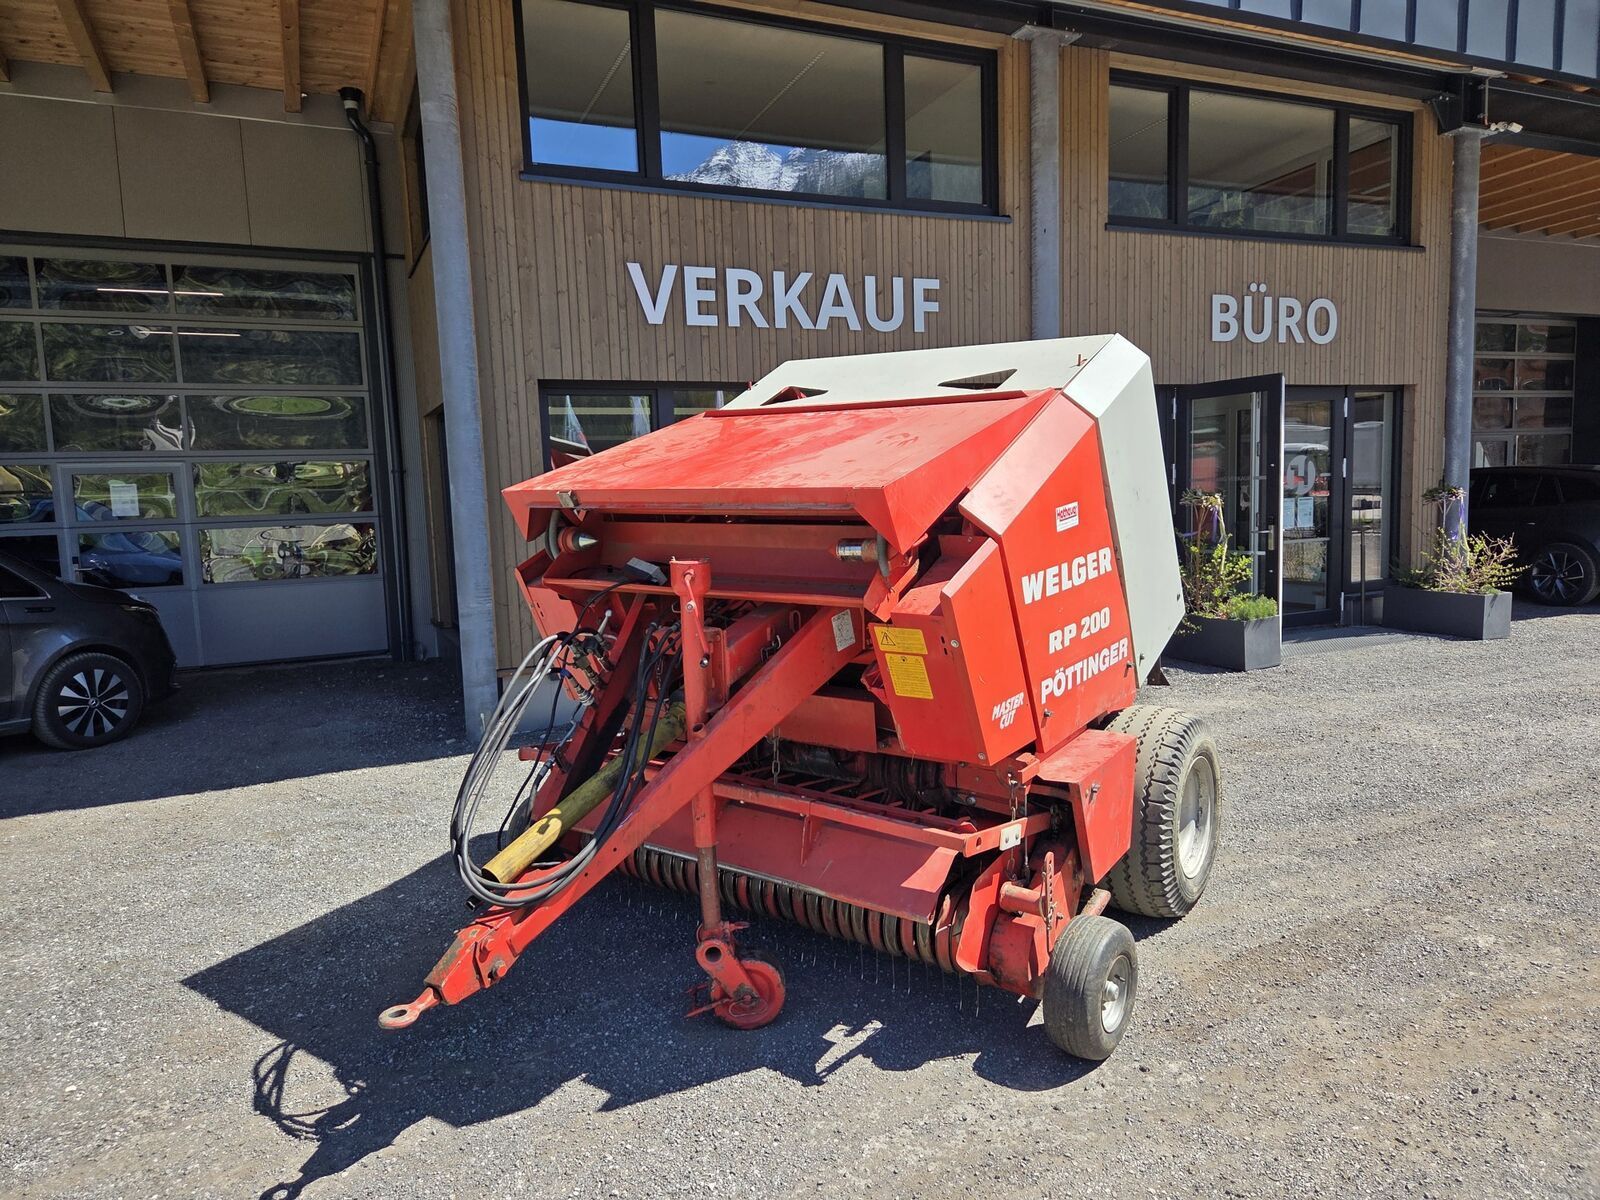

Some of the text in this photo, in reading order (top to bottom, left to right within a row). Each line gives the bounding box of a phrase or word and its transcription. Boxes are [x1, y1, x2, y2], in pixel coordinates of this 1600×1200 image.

[626, 262, 941, 334] VERKAUF
[1211, 282, 1338, 345] BÜRO
[1021, 547, 1112, 605] WELGER
[1049, 607, 1111, 654] RP 200
[1041, 637, 1128, 705] PÖTTINGER
[992, 691, 1025, 722] MASTER
[999, 708, 1017, 730] CUT
